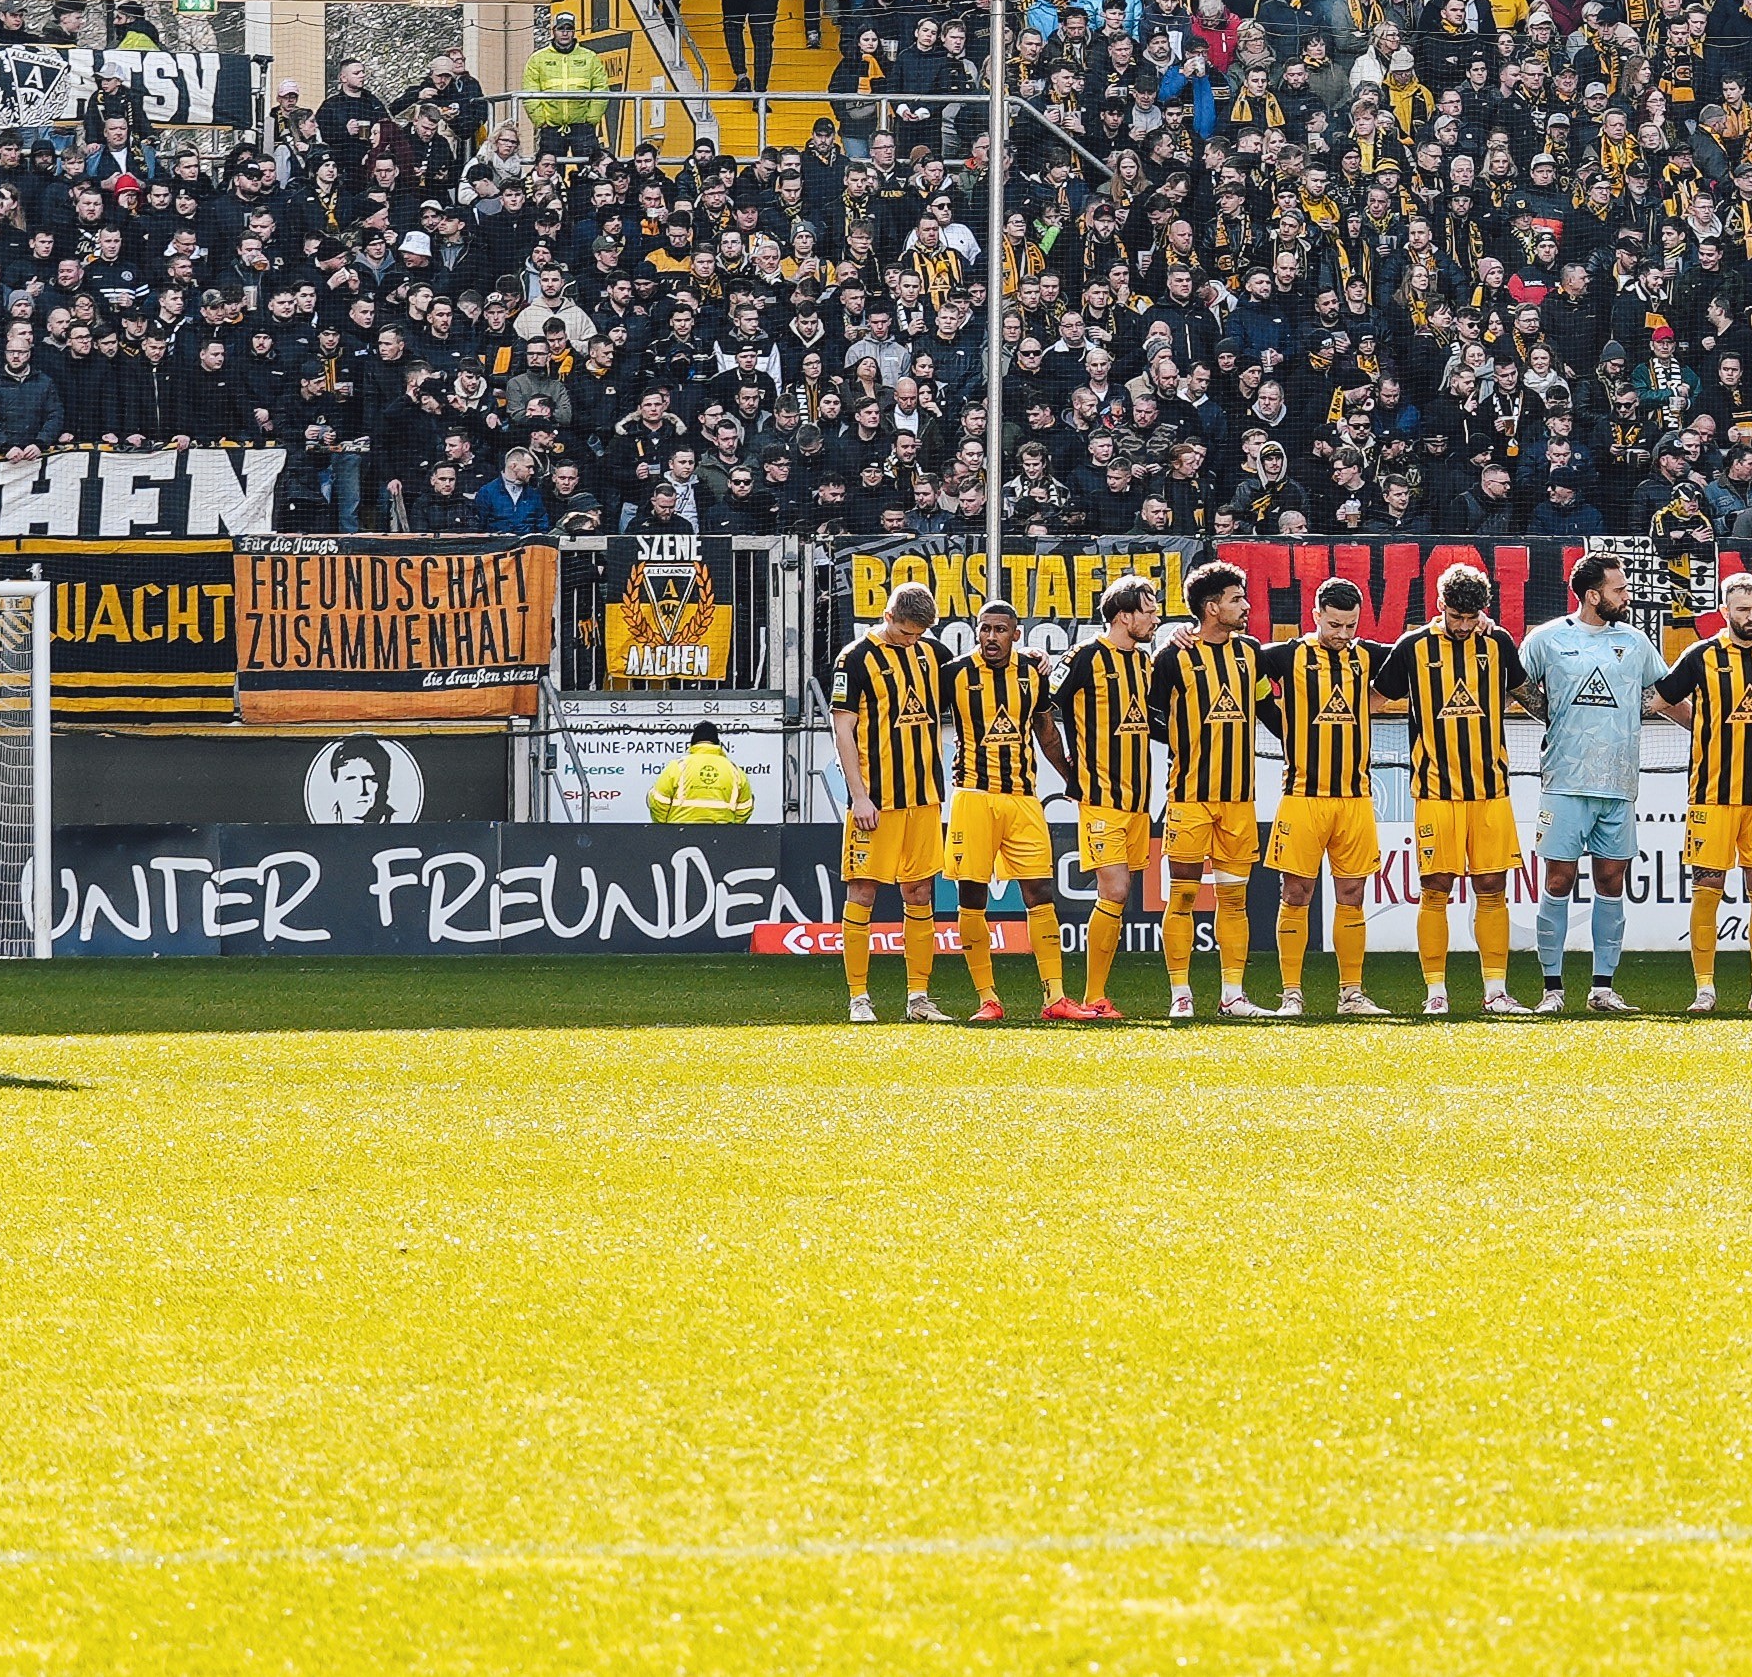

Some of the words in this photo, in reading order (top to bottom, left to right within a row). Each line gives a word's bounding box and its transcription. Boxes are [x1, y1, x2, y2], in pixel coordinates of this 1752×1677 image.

[240, 536, 270, 553] Für
[270, 537, 294, 553] die
[637, 535, 703, 561] SZENE
[251, 548, 527, 612] FREUNDSCHAFT
[245, 606, 530, 670] ZUSAMMENHALT
[625, 645, 710, 677] AACHEN
[422, 672, 447, 688] die
[447, 669, 500, 689] draußen
[563, 701, 580, 714] S4
[609, 701, 626, 714] S4
[657, 701, 674, 714] S4
[703, 701, 720, 714] S4
[749, 701, 766, 714] S4
[564, 740, 695, 755] NLINE-PARTNER
[564, 763, 625, 776] Hsense
[23, 848, 331, 943] UNTER
[370, 844, 834, 942] FREUNDEN
[817, 924, 1006, 952] camcntol
